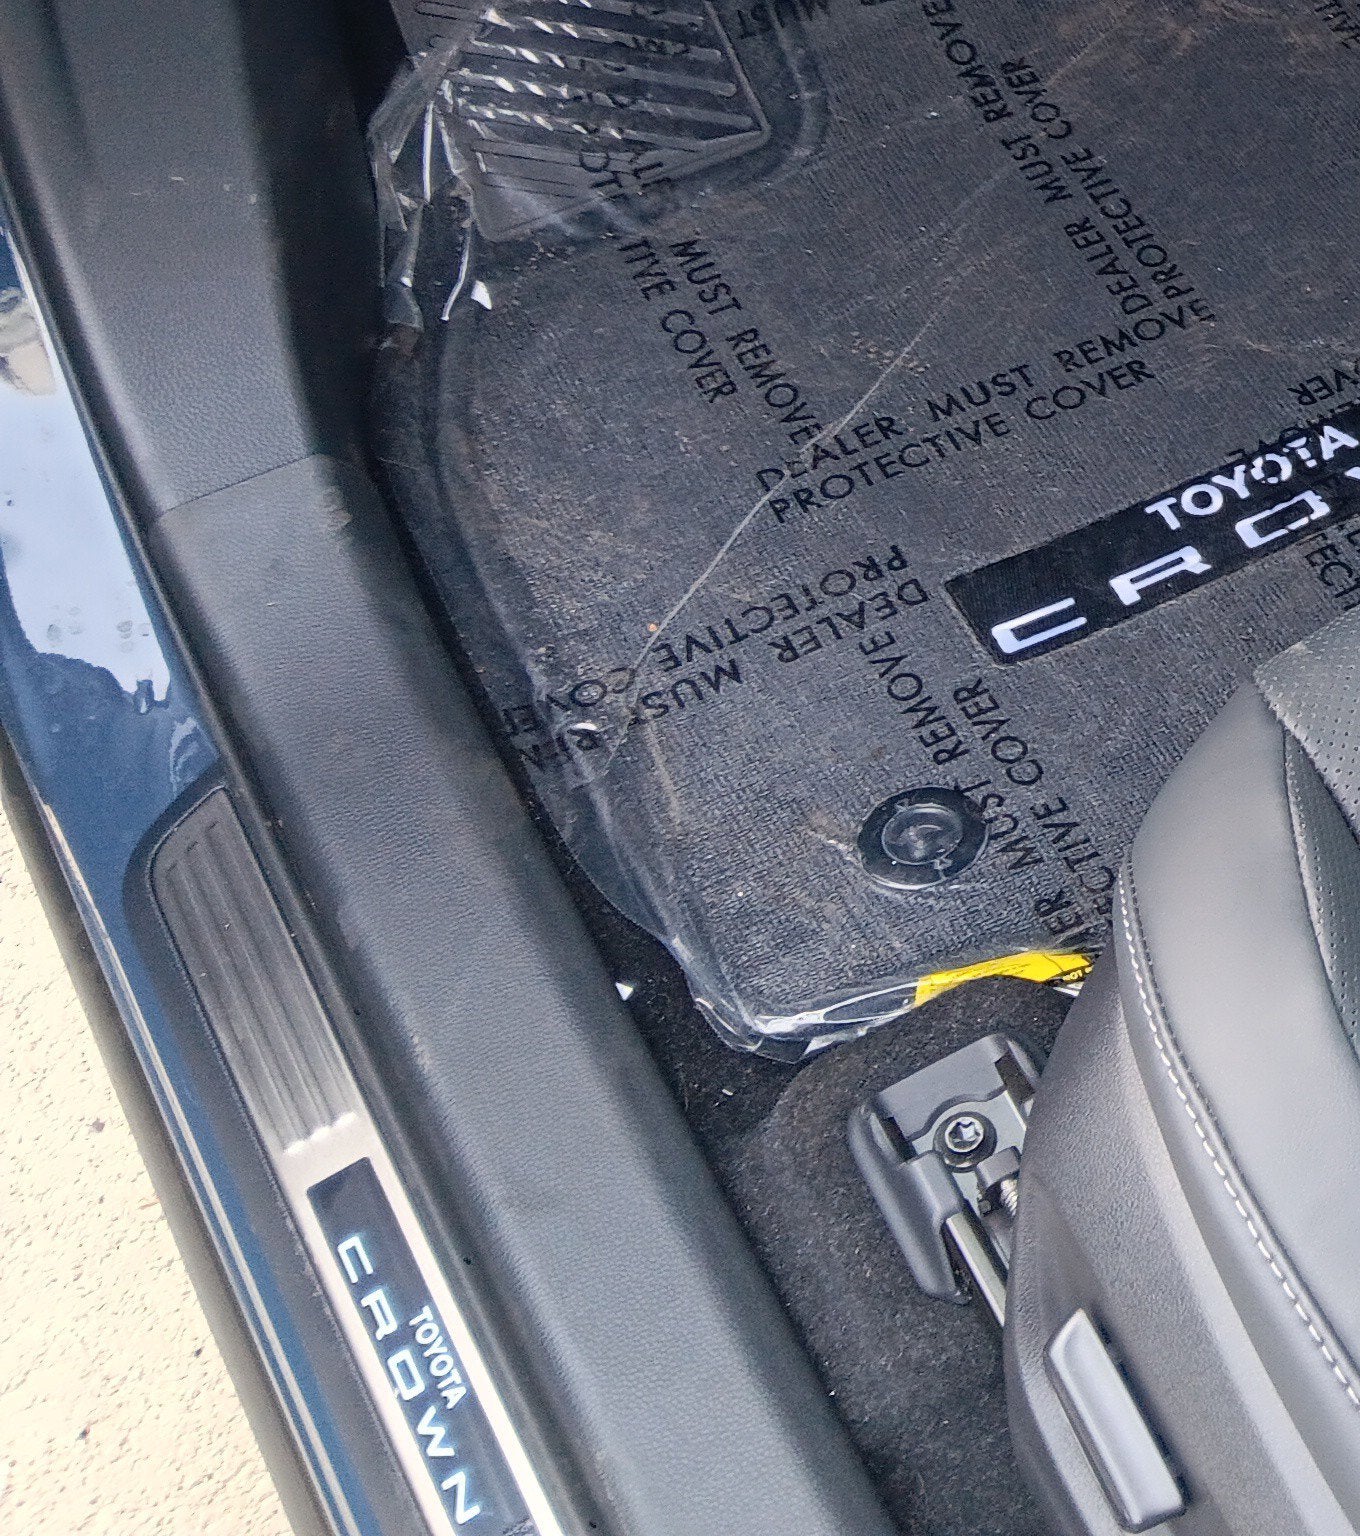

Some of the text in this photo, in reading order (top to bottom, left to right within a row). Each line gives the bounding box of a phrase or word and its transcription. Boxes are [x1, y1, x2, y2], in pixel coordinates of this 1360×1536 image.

[1000, 57, 1195, 300] PROTECTIVE COVER
[1001, 133, 1073, 204] MUST
[1062, 216, 1152, 315] DEALER
[660, 309, 738, 404] COVER
[669, 237, 823, 446] MUST REMOVE
[756, 297, 1217, 493] DEALER MUST REMOVE
[766, 360, 1158, 524] PROTECTIVE COVER
[1144, 424, 1359, 531] TOYOTA
[650, 544, 912, 673] PROTECTIVE
[768, 577, 930, 663] DEALER
[858, 630, 1045, 871] MUST REMOVE
[952, 676, 1044, 786] COVER
[337, 1234, 482, 1525] CROWN
[408, 1304, 467, 1409] TOYOTA
